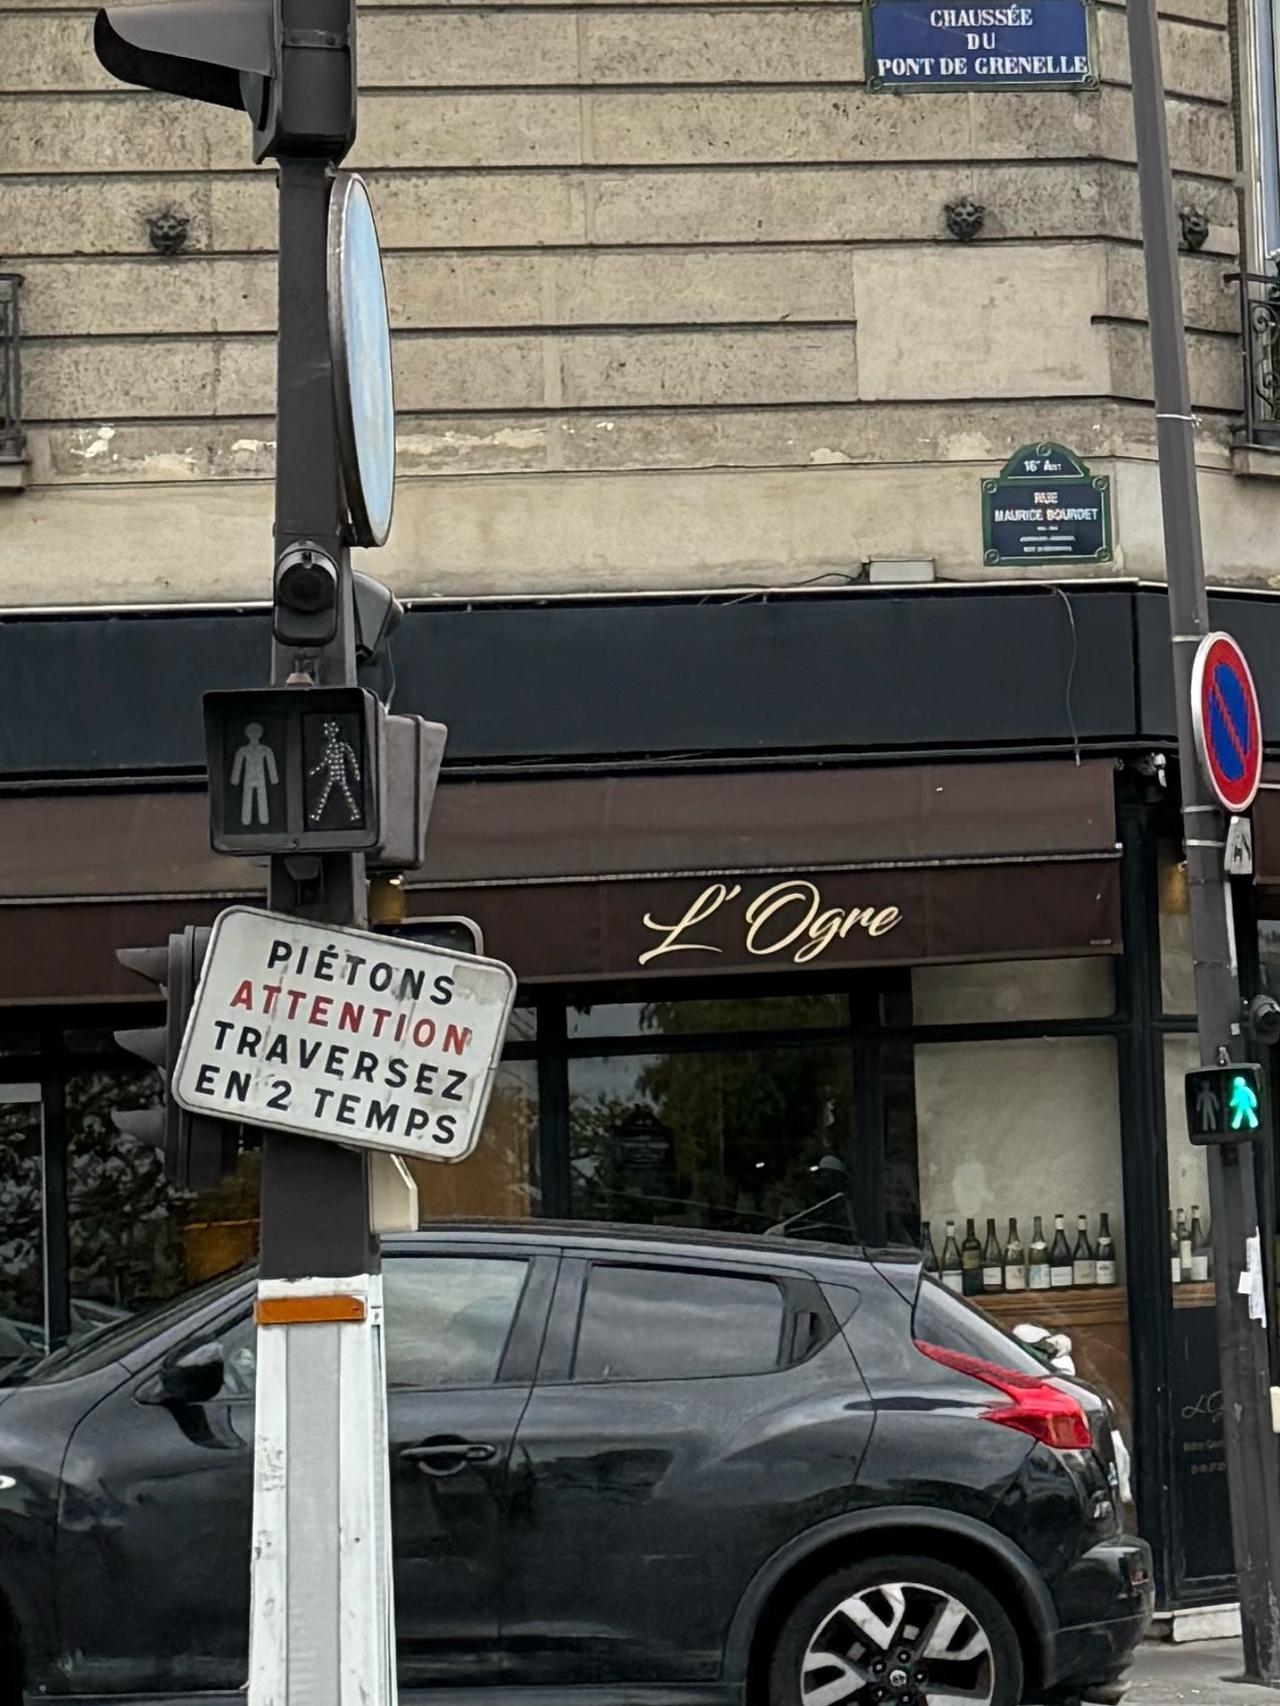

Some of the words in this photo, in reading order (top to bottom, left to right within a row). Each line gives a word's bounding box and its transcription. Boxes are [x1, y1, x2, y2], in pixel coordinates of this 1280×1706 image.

[930, 4, 1033, 27] CHAUSSÉE
[966, 33, 996, 50] DU
[877, 57, 935, 77] PONT
[940, 57, 967, 75] DE
[974, 56, 1088, 75] GRENELLE
[994, 509, 1044, 522] MAURICE
[1046, 508, 1098, 520] BOURDET
[1034, 492, 1059, 504] RUE
[638, 879, 902, 965] L'Ogre
[266, 939, 455, 1006] PIÉTONS
[229, 979, 473, 1056] ATTENTION
[213, 1020, 468, 1101] TRAVERSEZ
[194, 1063, 252, 1103] EN
[265, 1079, 293, 1111] 2
[313, 1087, 458, 1144] TEMPS
